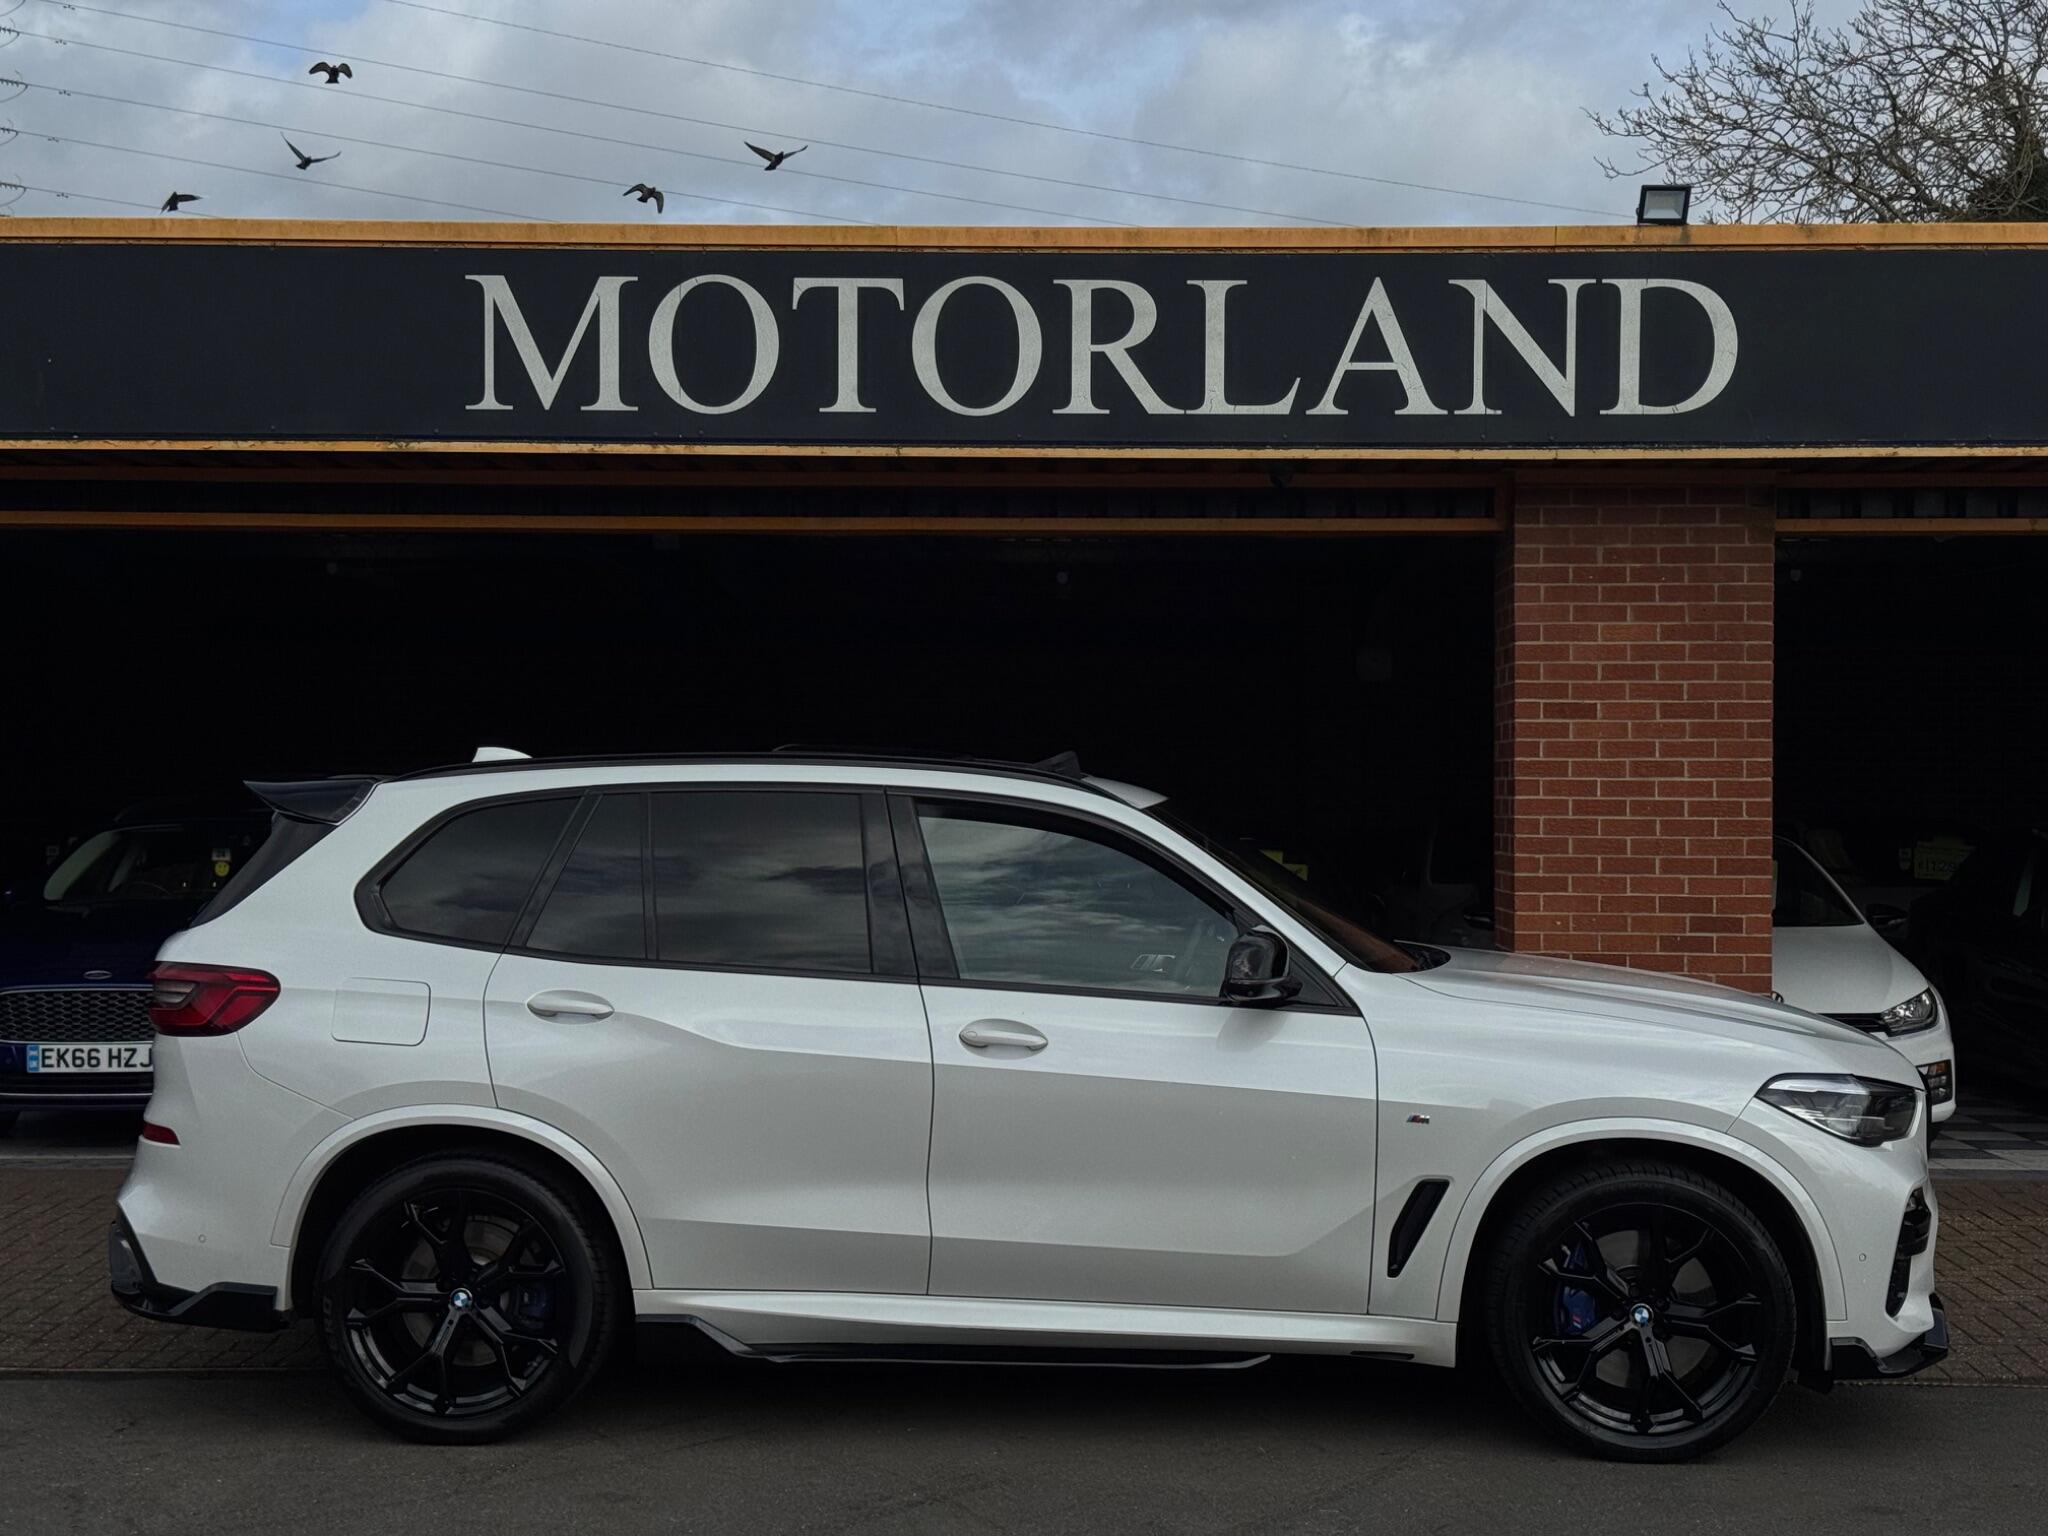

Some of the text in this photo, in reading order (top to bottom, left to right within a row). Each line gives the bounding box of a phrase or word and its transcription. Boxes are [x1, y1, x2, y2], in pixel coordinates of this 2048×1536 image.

[465, 273, 1738, 418] MOTORLAND
[41, 1048, 153, 1068] EK66 HZJ
